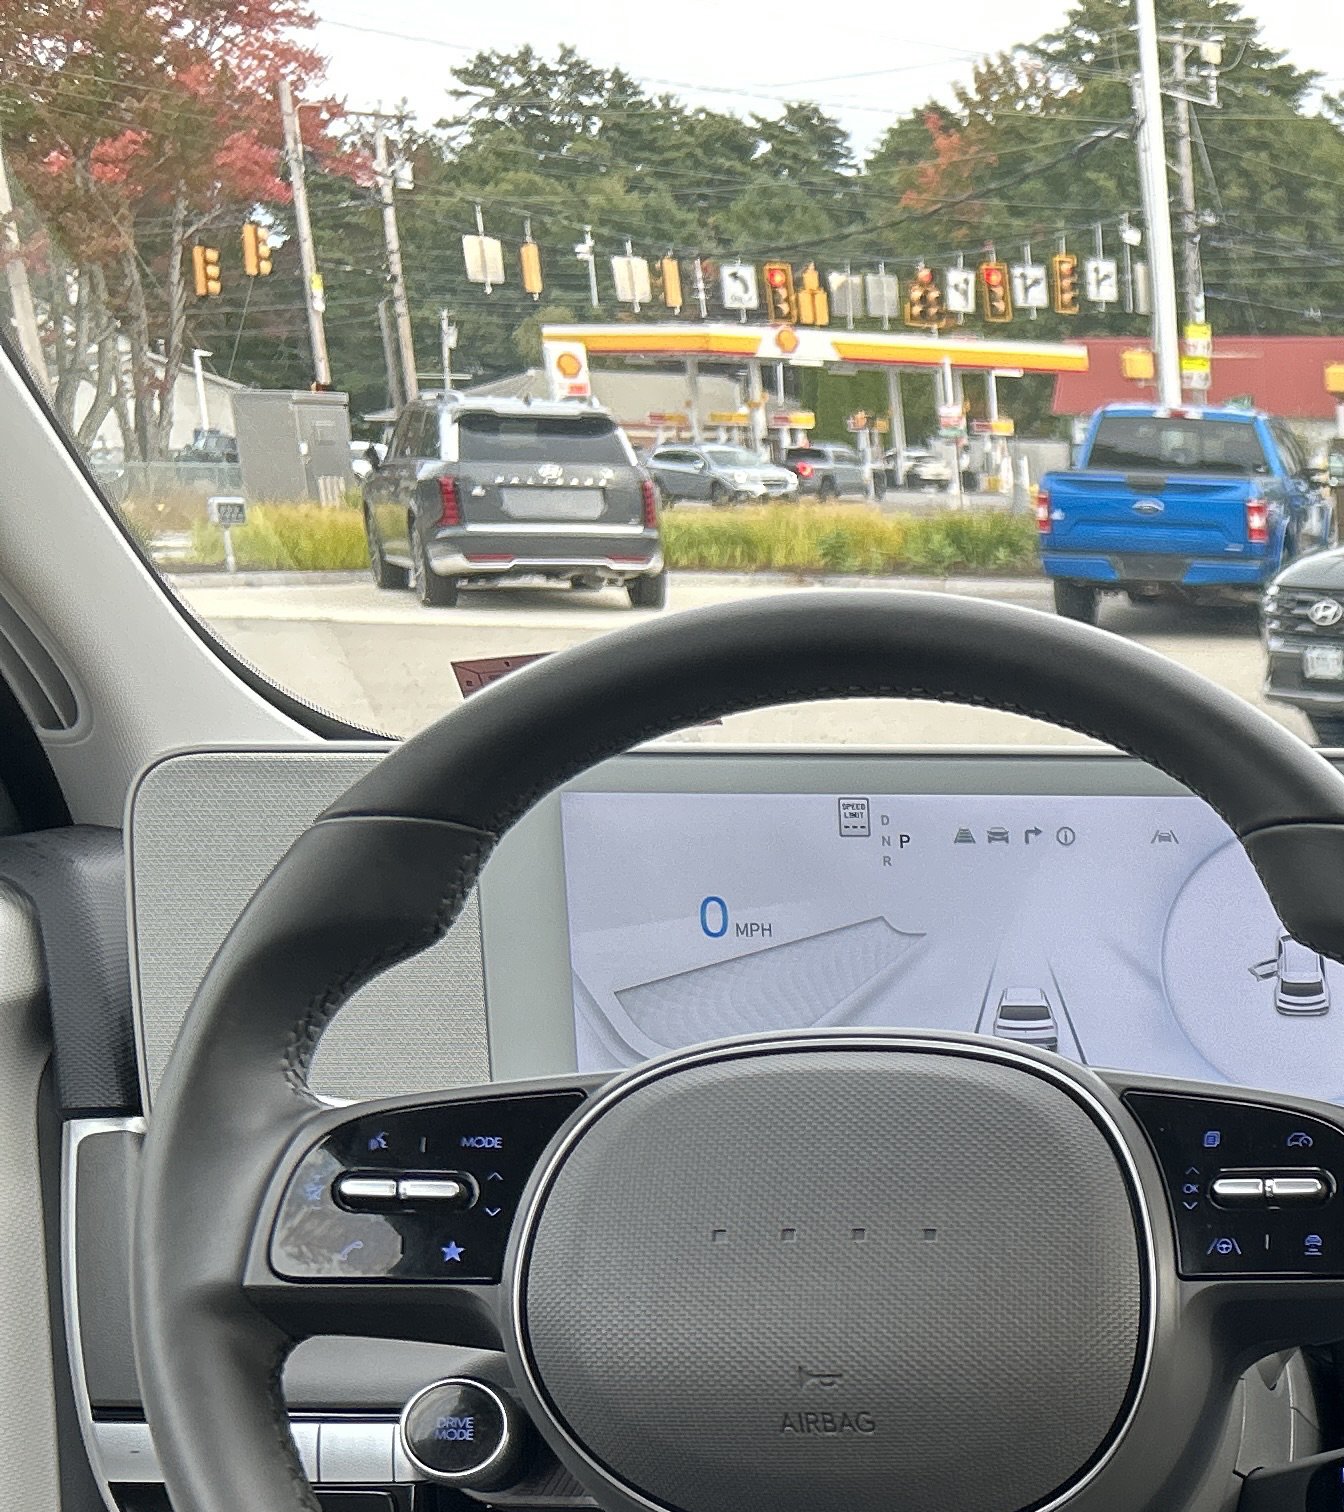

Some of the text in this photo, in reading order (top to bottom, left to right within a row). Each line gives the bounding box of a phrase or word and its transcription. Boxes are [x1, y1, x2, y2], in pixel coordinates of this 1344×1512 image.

[842, 803, 866, 811] SPEED
[881, 815, 890, 826] D
[881, 836, 891, 847] N
[899, 834, 911, 849] P
[883, 856, 892, 867] R
[700, 896, 773, 938] 0 MPH
[460, 1136, 503, 1149] MODE
[436, 1416, 474, 1429] DRIVE
[781, 1411, 876, 1434] AIRBAG
[432, 1428, 475, 1441] MODE
